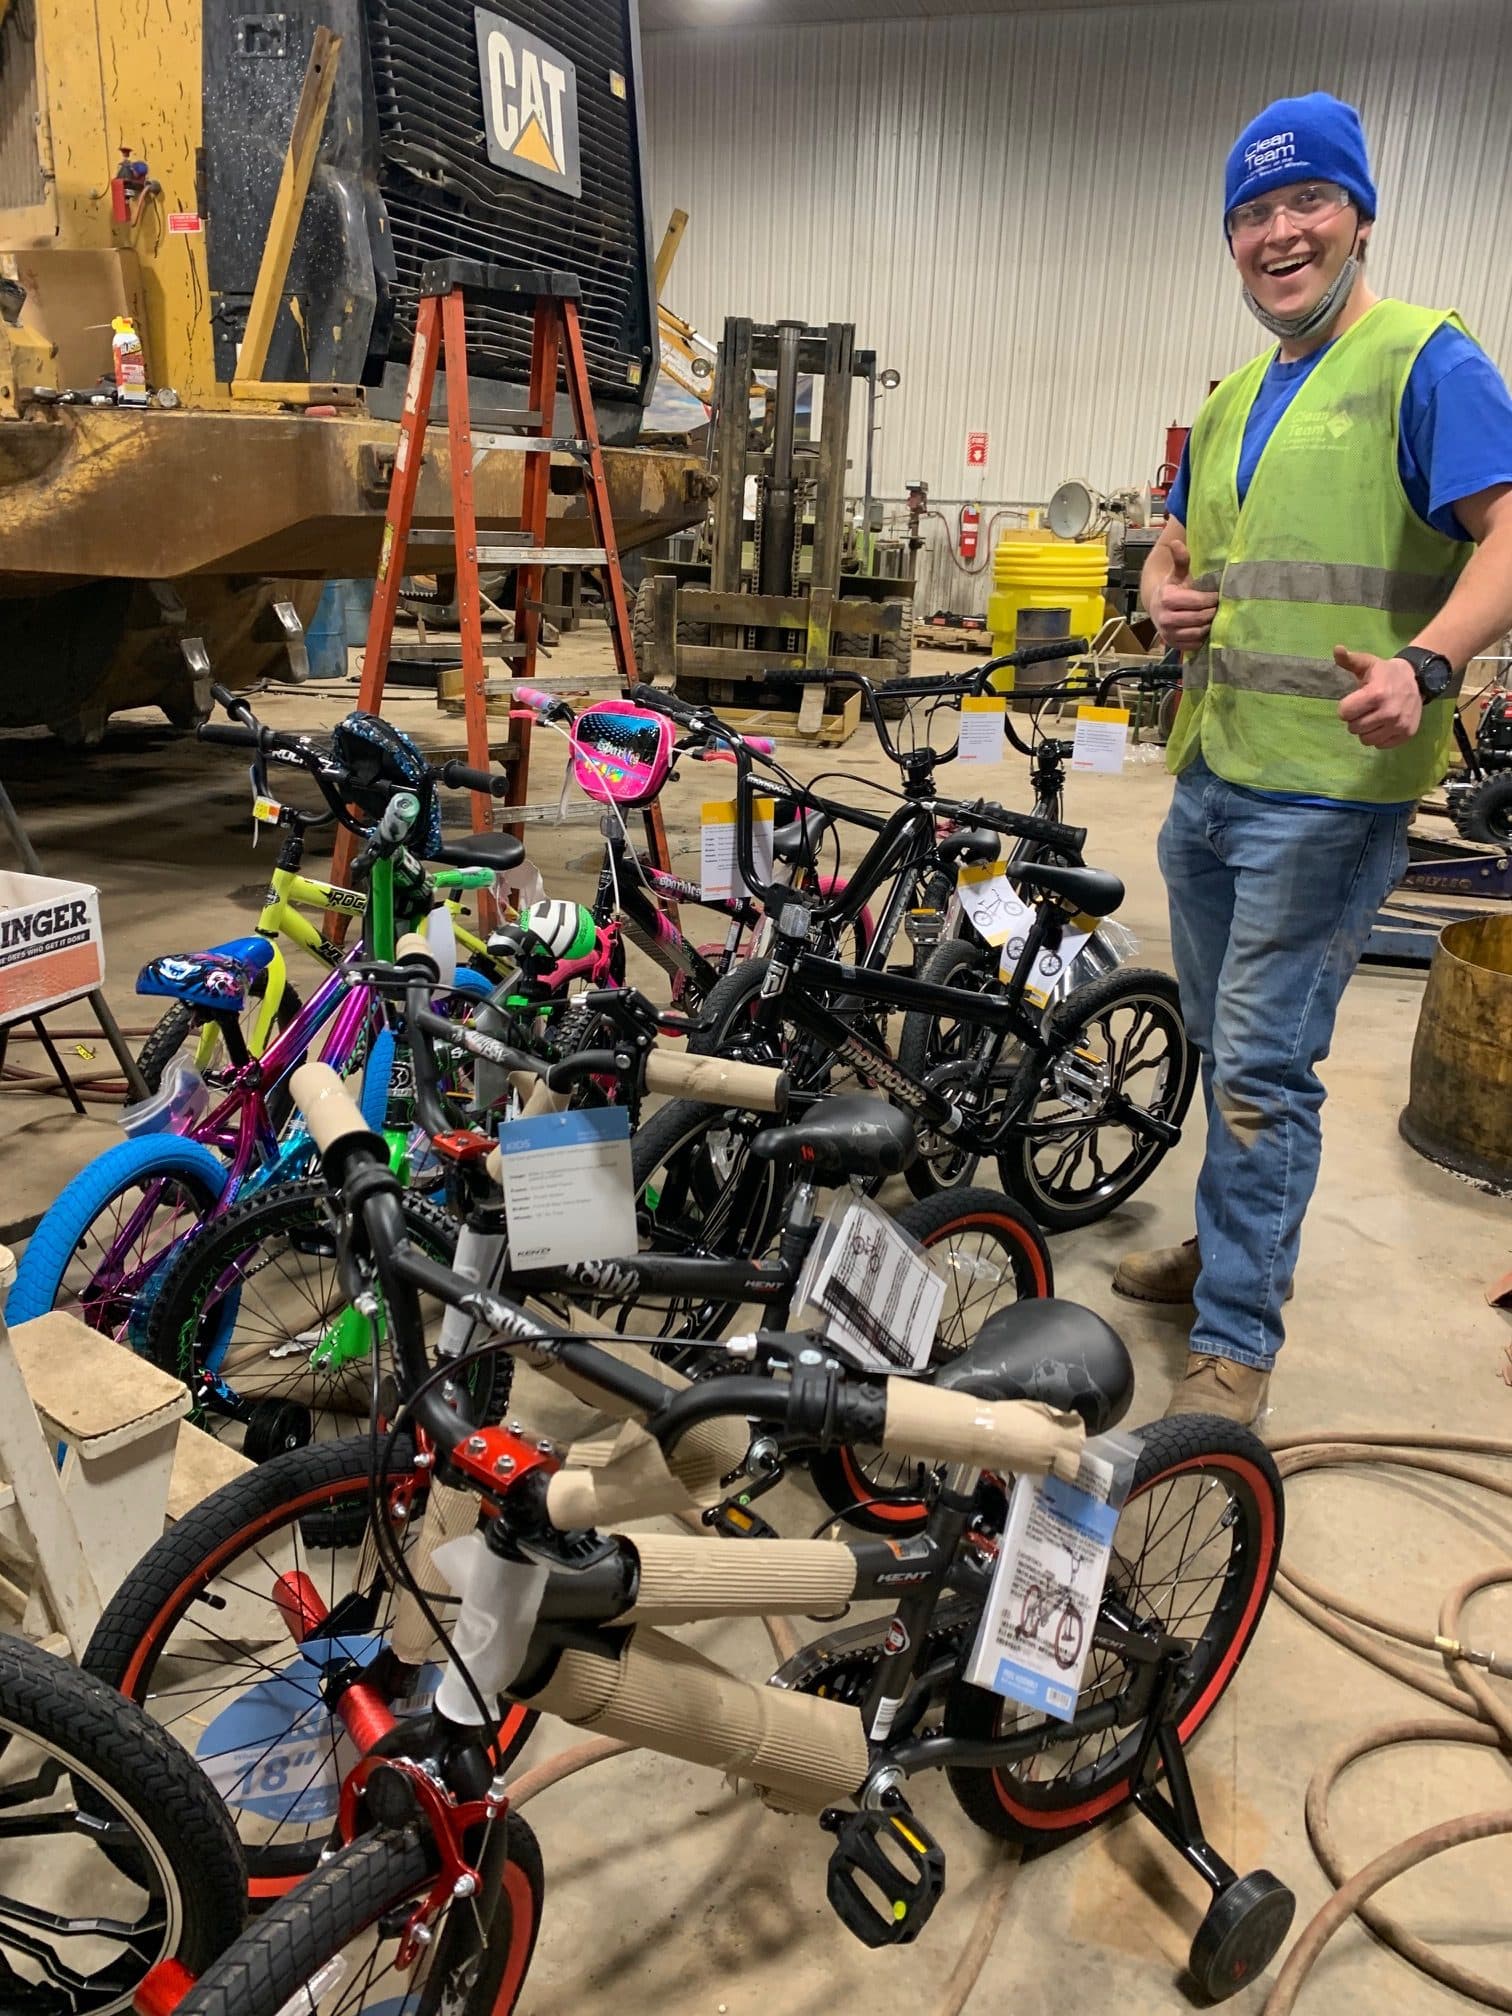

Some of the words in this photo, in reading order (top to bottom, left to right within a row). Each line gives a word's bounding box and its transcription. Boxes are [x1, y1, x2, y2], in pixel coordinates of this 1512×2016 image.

[488, 31, 566, 176] CAT
[1245, 131, 1294, 156] Clean
[1244, 144, 1295, 170] Team
[0, 900, 88, 949] INGER
[45, 941, 59, 951] GET
[59, 938, 66, 947] IT
[836, 1036, 927, 1107] mongoose
[744, 1279, 785, 1289] KENT
[876, 1570, 932, 1583] KENT
